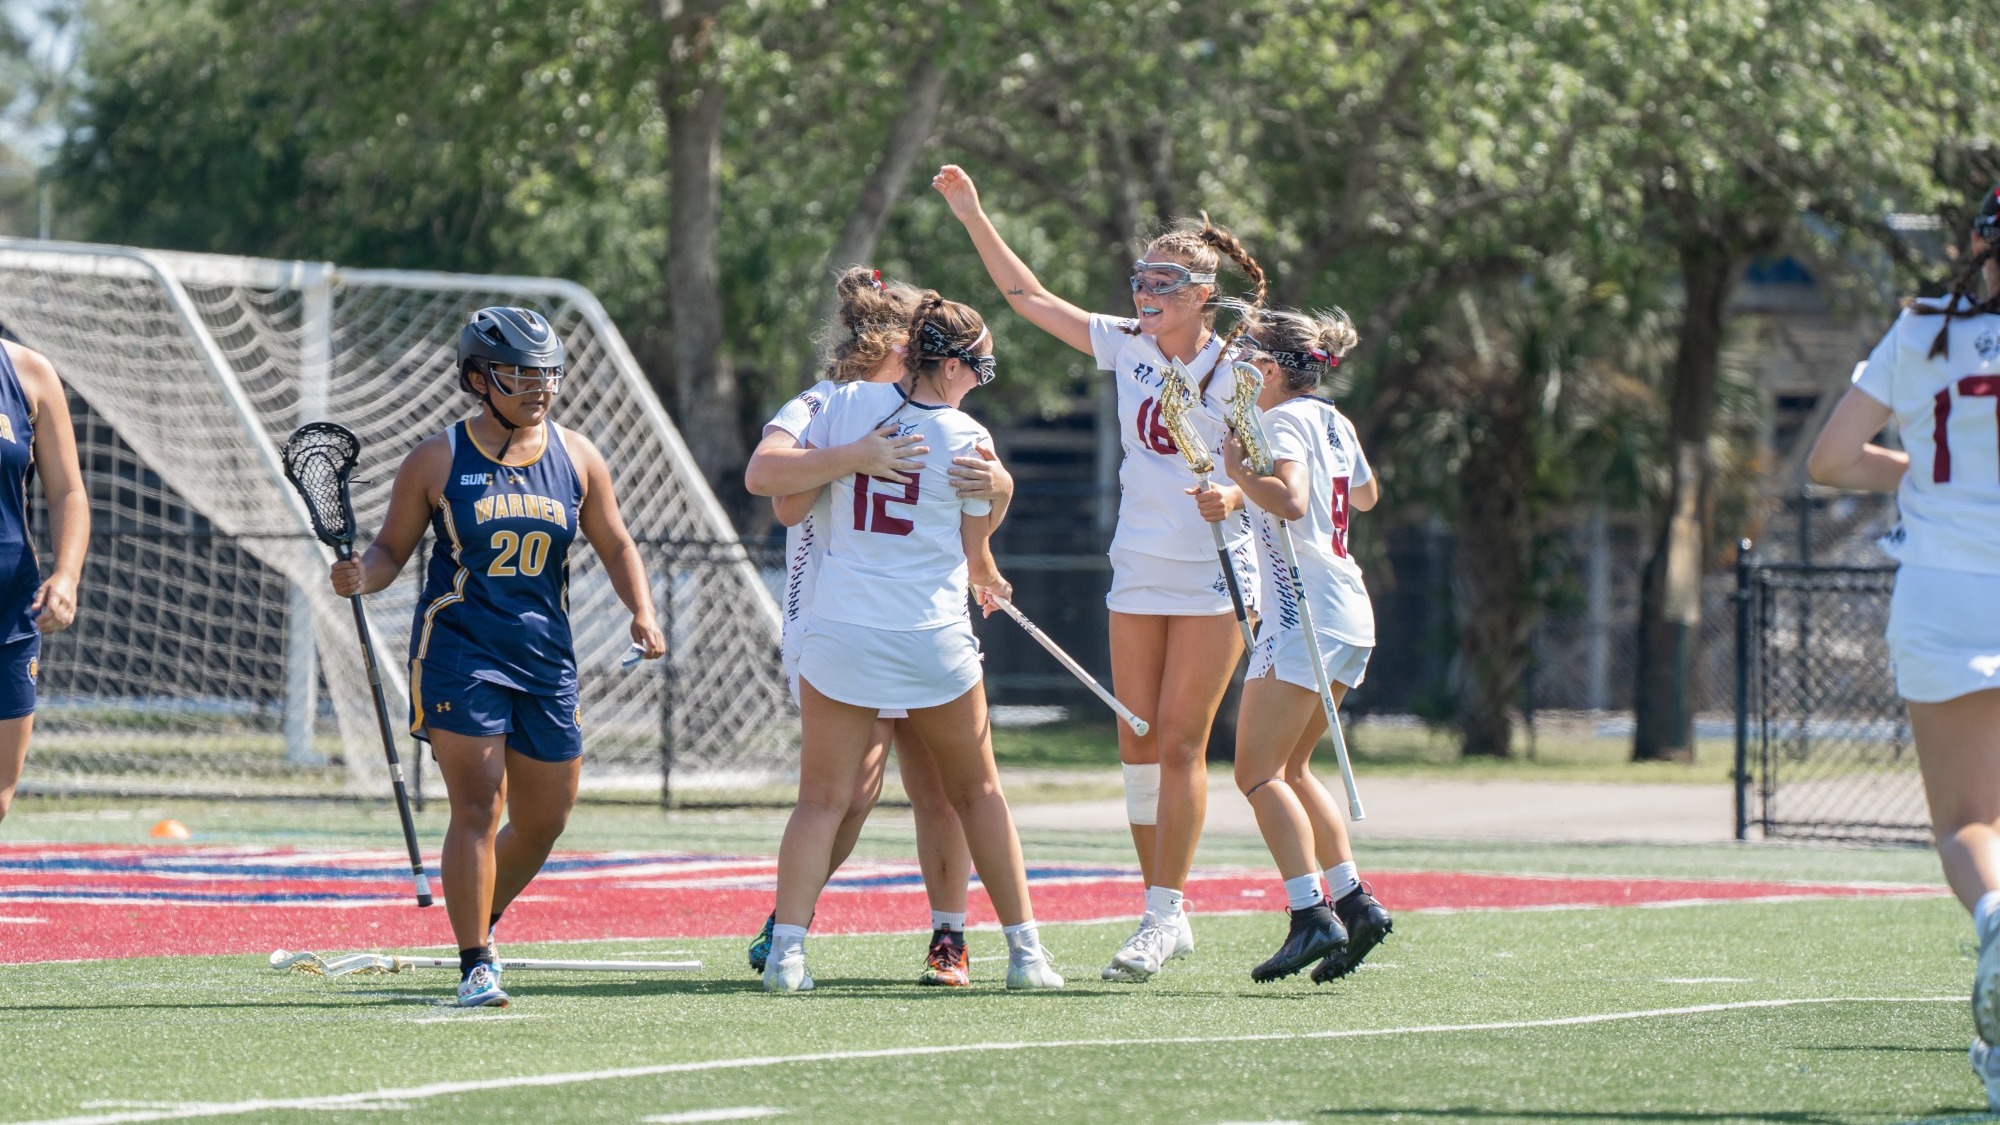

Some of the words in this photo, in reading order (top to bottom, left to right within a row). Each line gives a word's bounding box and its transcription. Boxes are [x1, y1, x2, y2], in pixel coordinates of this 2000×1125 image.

[923, 324, 946, 342] STX
[1271, 350, 1296, 360] STX
[1305, 363, 1321, 371] STX
[474, 494, 568, 530] WARNER
[853, 470, 921, 536] 12
[488, 531, 552, 577] 20
[1288, 565, 1307, 602] STX
